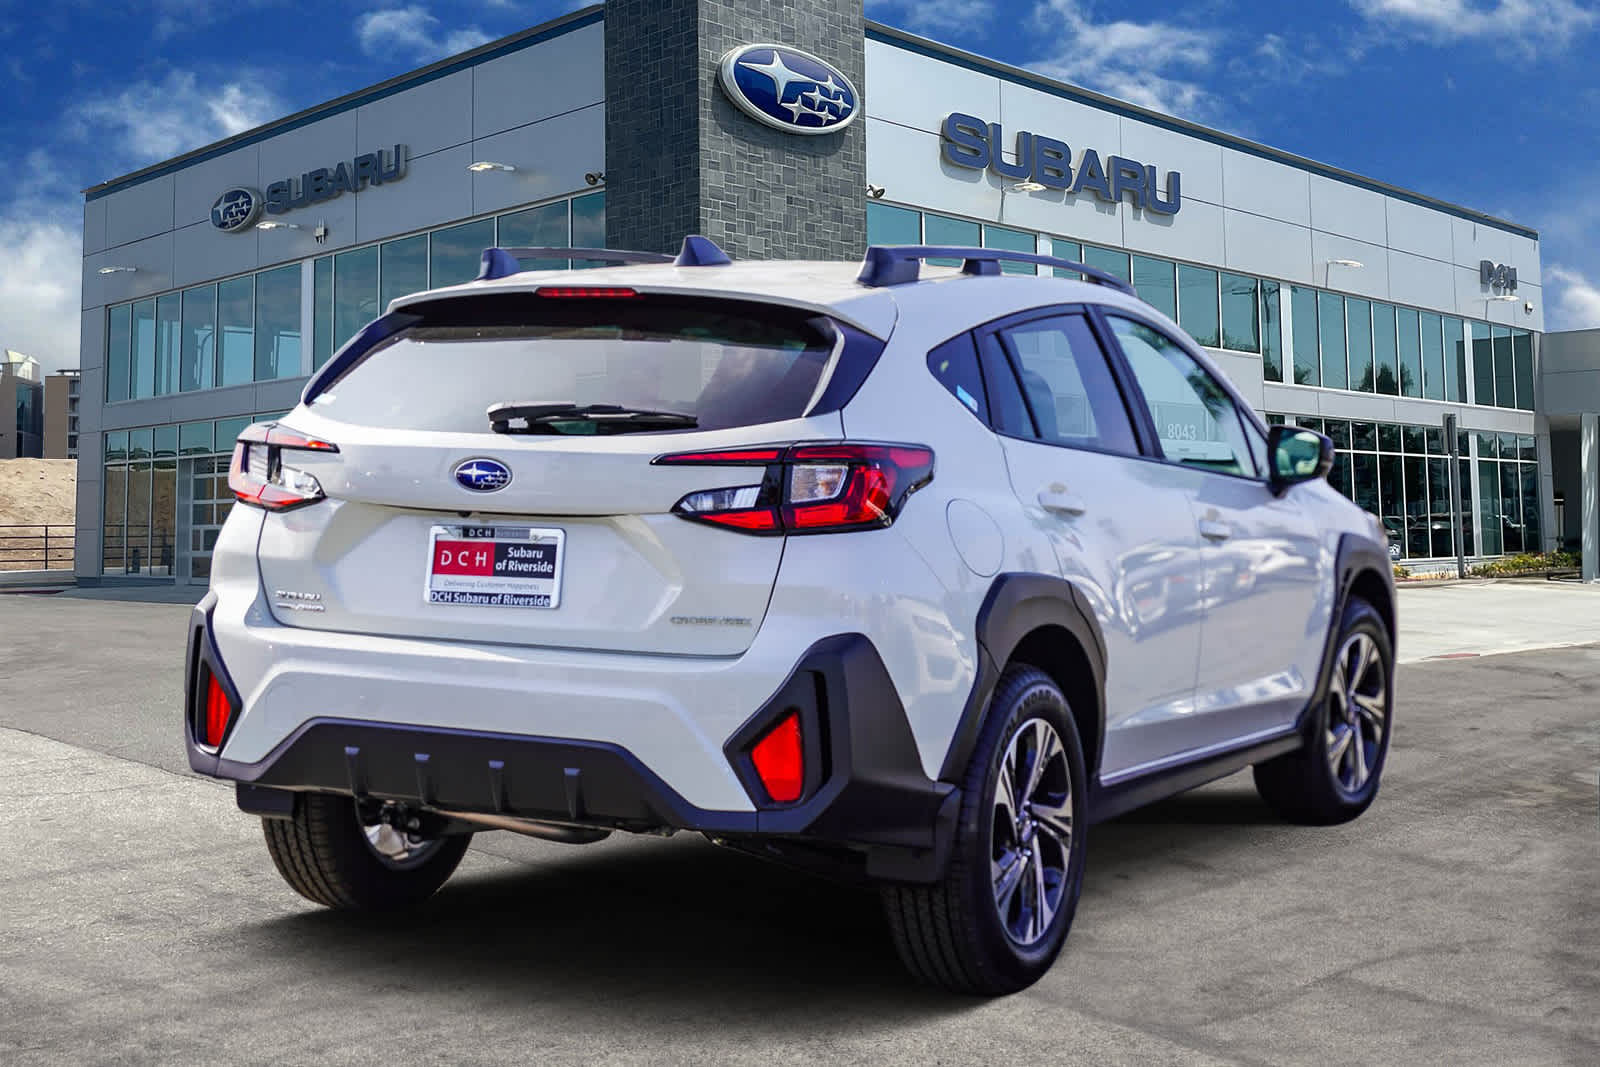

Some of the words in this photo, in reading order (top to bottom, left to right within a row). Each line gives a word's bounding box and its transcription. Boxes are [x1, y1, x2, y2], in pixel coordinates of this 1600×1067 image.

[942, 112, 1181, 216] SUBARU
[266, 143, 408, 215] SUBARU
[1167, 423, 1197, 440] 8043
[440, 550, 487, 567] DCH
[507, 547, 543, 559] Subaru
[495, 560, 507, 571] of
[508, 560, 553, 573] Riverside
[431, 591, 452, 602] DCH
[453, 592, 489, 604] Subaru
[490, 593, 502, 604] of
[503, 594, 550, 607] Riverside
